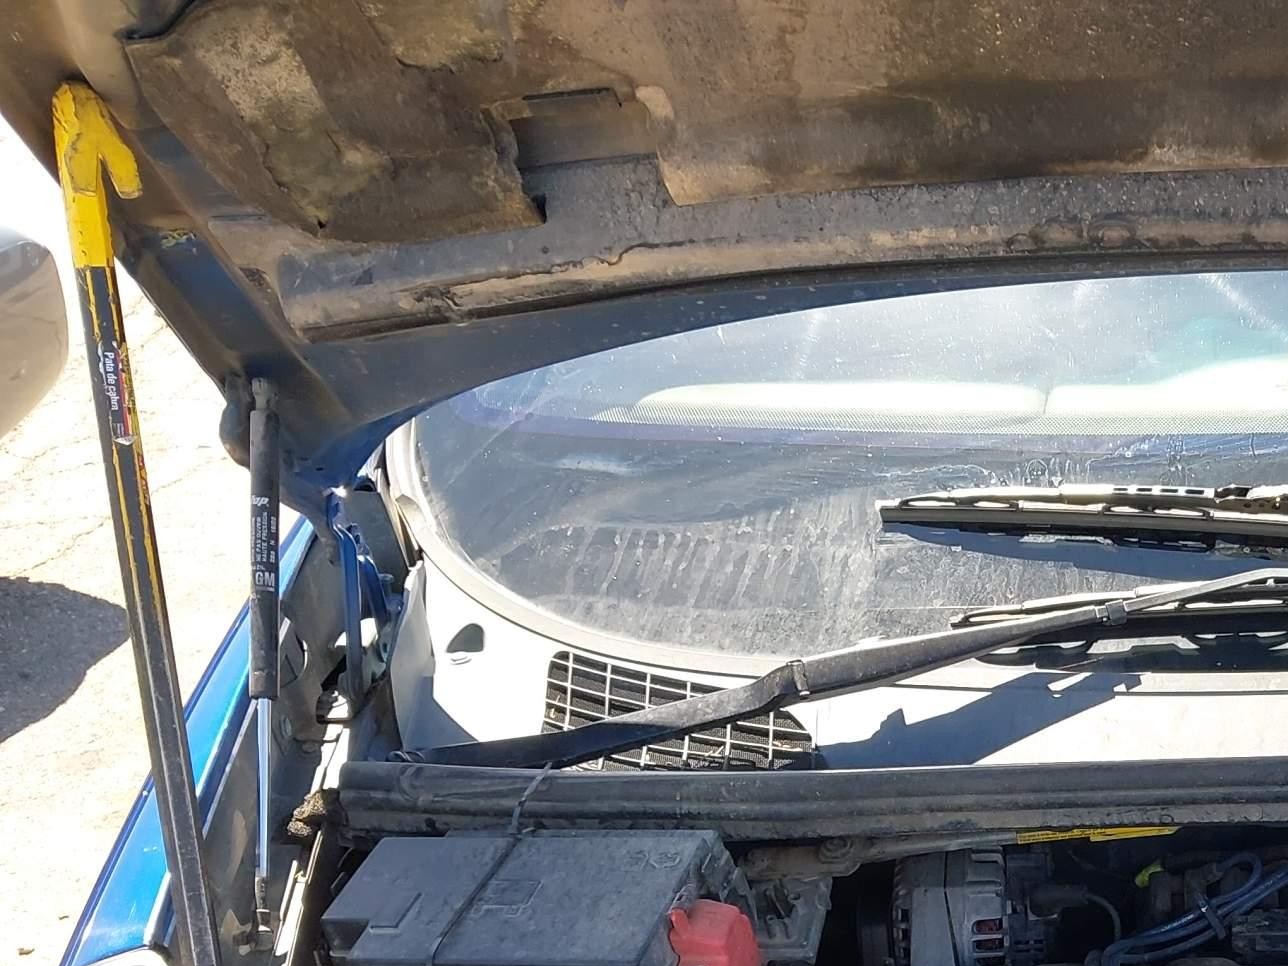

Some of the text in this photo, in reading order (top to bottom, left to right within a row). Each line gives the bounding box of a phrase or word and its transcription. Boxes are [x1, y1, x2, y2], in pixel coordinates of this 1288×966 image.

[104, 352, 115, 372] Pata
[107, 372, 115, 385] de
[255, 571, 275, 587] GM
